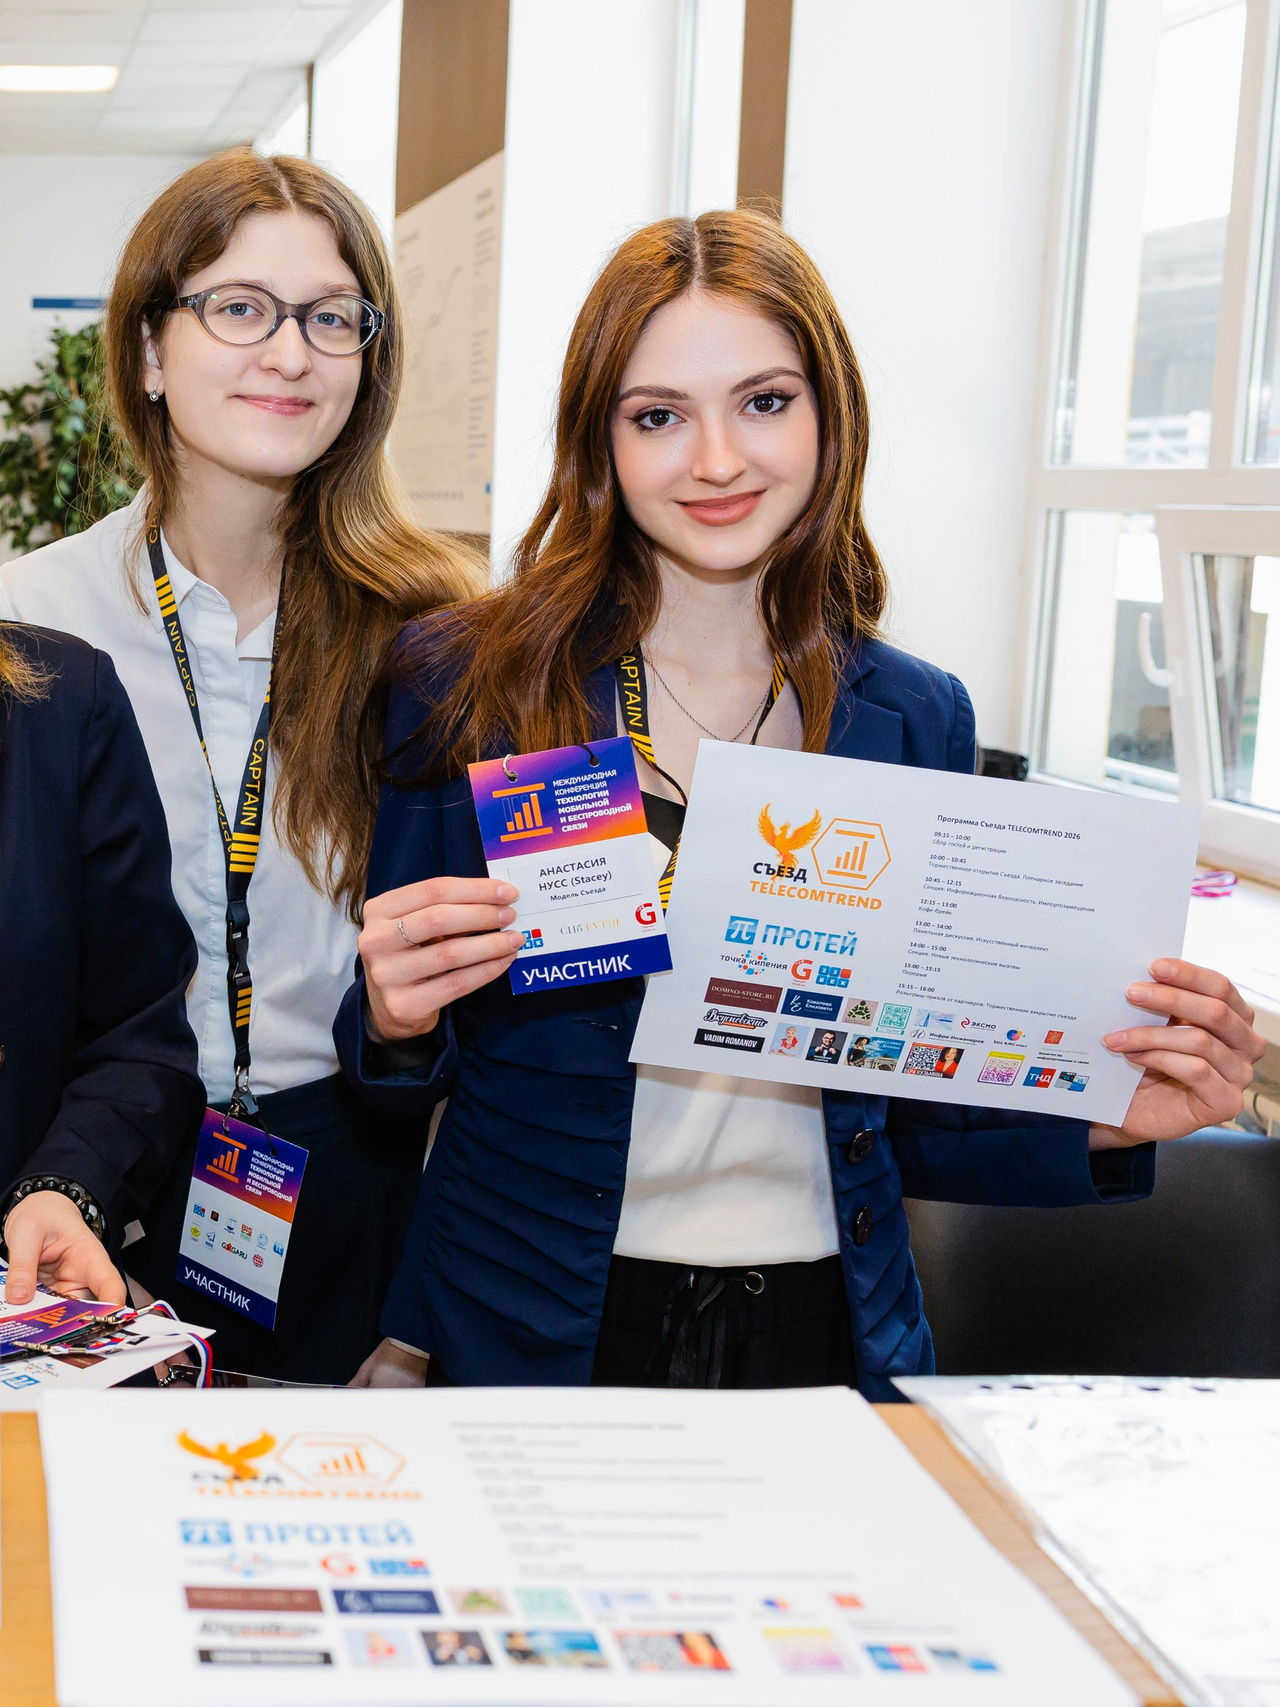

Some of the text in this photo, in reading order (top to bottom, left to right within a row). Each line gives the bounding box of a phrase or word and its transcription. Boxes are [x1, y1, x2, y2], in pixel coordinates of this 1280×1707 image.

[167, 620, 196, 707] CAPTAIN
[620, 654, 643, 727] APTAIN
[240, 738, 265, 828] CAPTAIN
[552, 769, 617, 787] МЕЖДУНАРОДНАЯ
[554, 781, 607, 796] КОНФЕРЕНЦИЯ
[556, 790, 609, 805] ТЕХНОЛОГИИ
[558, 798, 610, 814] МОБИЛЬНОЙ
[568, 803, 632, 822] БЕСПРОВОДНОЙ
[562, 822, 588, 833] СВЯЗИ
[934, 831, 950, 839] 09:15
[937, 814, 1081, 840] Программа Съезда TELECOMTREND 2026
[933, 839, 947, 847] Сбор
[948, 841, 966, 849] гостей
[972, 844, 1007, 854] регистрация
[539, 857, 606, 877] АНАСТАСИЯ
[930, 854, 945, 862] 10:00
[951, 856, 966, 864] 10:45
[538, 870, 612, 892] НУСС (Stacey)
[753, 862, 808, 883] СЪЕЗД
[925, 876, 941, 884] 10:45
[928, 862, 972, 873] Торжественное
[973, 868, 999, 877] открытие
[1023, 874, 1053, 884] Пленарное
[1055, 879, 1084, 888] заседание
[550, 886, 606, 902] Модель Съезда
[750, 880, 882, 910] TELECOMTREND
[923, 884, 945, 893] Секция:
[947, 887, 997, 899] Информационная
[1038, 900, 1095, 913] Импортозамещение
[920, 898, 936, 906] 12:15
[942, 901, 957, 909] 13:00
[915, 920, 931, 928] 13:00
[762, 924, 858, 956] ПРОТЕЙ
[910, 941, 926, 949] 14:00
[913, 927, 1049, 952] Панельная дискуссия: Искусственный интеллект
[720, 955, 787, 970] точка кипения
[908, 949, 930, 957] Секция:
[951, 955, 998, 967] технологические
[999, 962, 1020, 970] вызовы
[522, 954, 632, 986] УЧАСТНИК
[902, 969, 927, 978] Перерыв
[925, 965, 941, 973] 15:15
[712, 986, 774, 999] DOMINO-STORE.RU
[898, 983, 914, 991] 15:15
[896, 989, 925, 1000] Розыгрыш
[926, 994, 945, 1002] призов
[986, 1001, 1029, 1014] Торжественное
[1030, 1008, 1056, 1017] закрытие
[1057, 1013, 1077, 1021] съезда
[971, 1021, 996, 1029] ЭКСМО
[704, 1033, 758, 1047] VADIM ROMANOV
[1029, 1073, 1052, 1083] ТНД
[248, 1170, 281, 1190] МОБИЛЬНОЙ
[249, 1163, 284, 1184] ТЕХНОЛОГИИ
[245, 1184, 263, 1197] СВЯЗИ
[252, 1179, 293, 1203] БЕСПРОВОДНОЙ
[241, 1223, 253, 1235] BIS
[184, 1266, 251, 1311] УЧАСТНИК
[245, 1518, 414, 1546] ПРОТЕЙ
